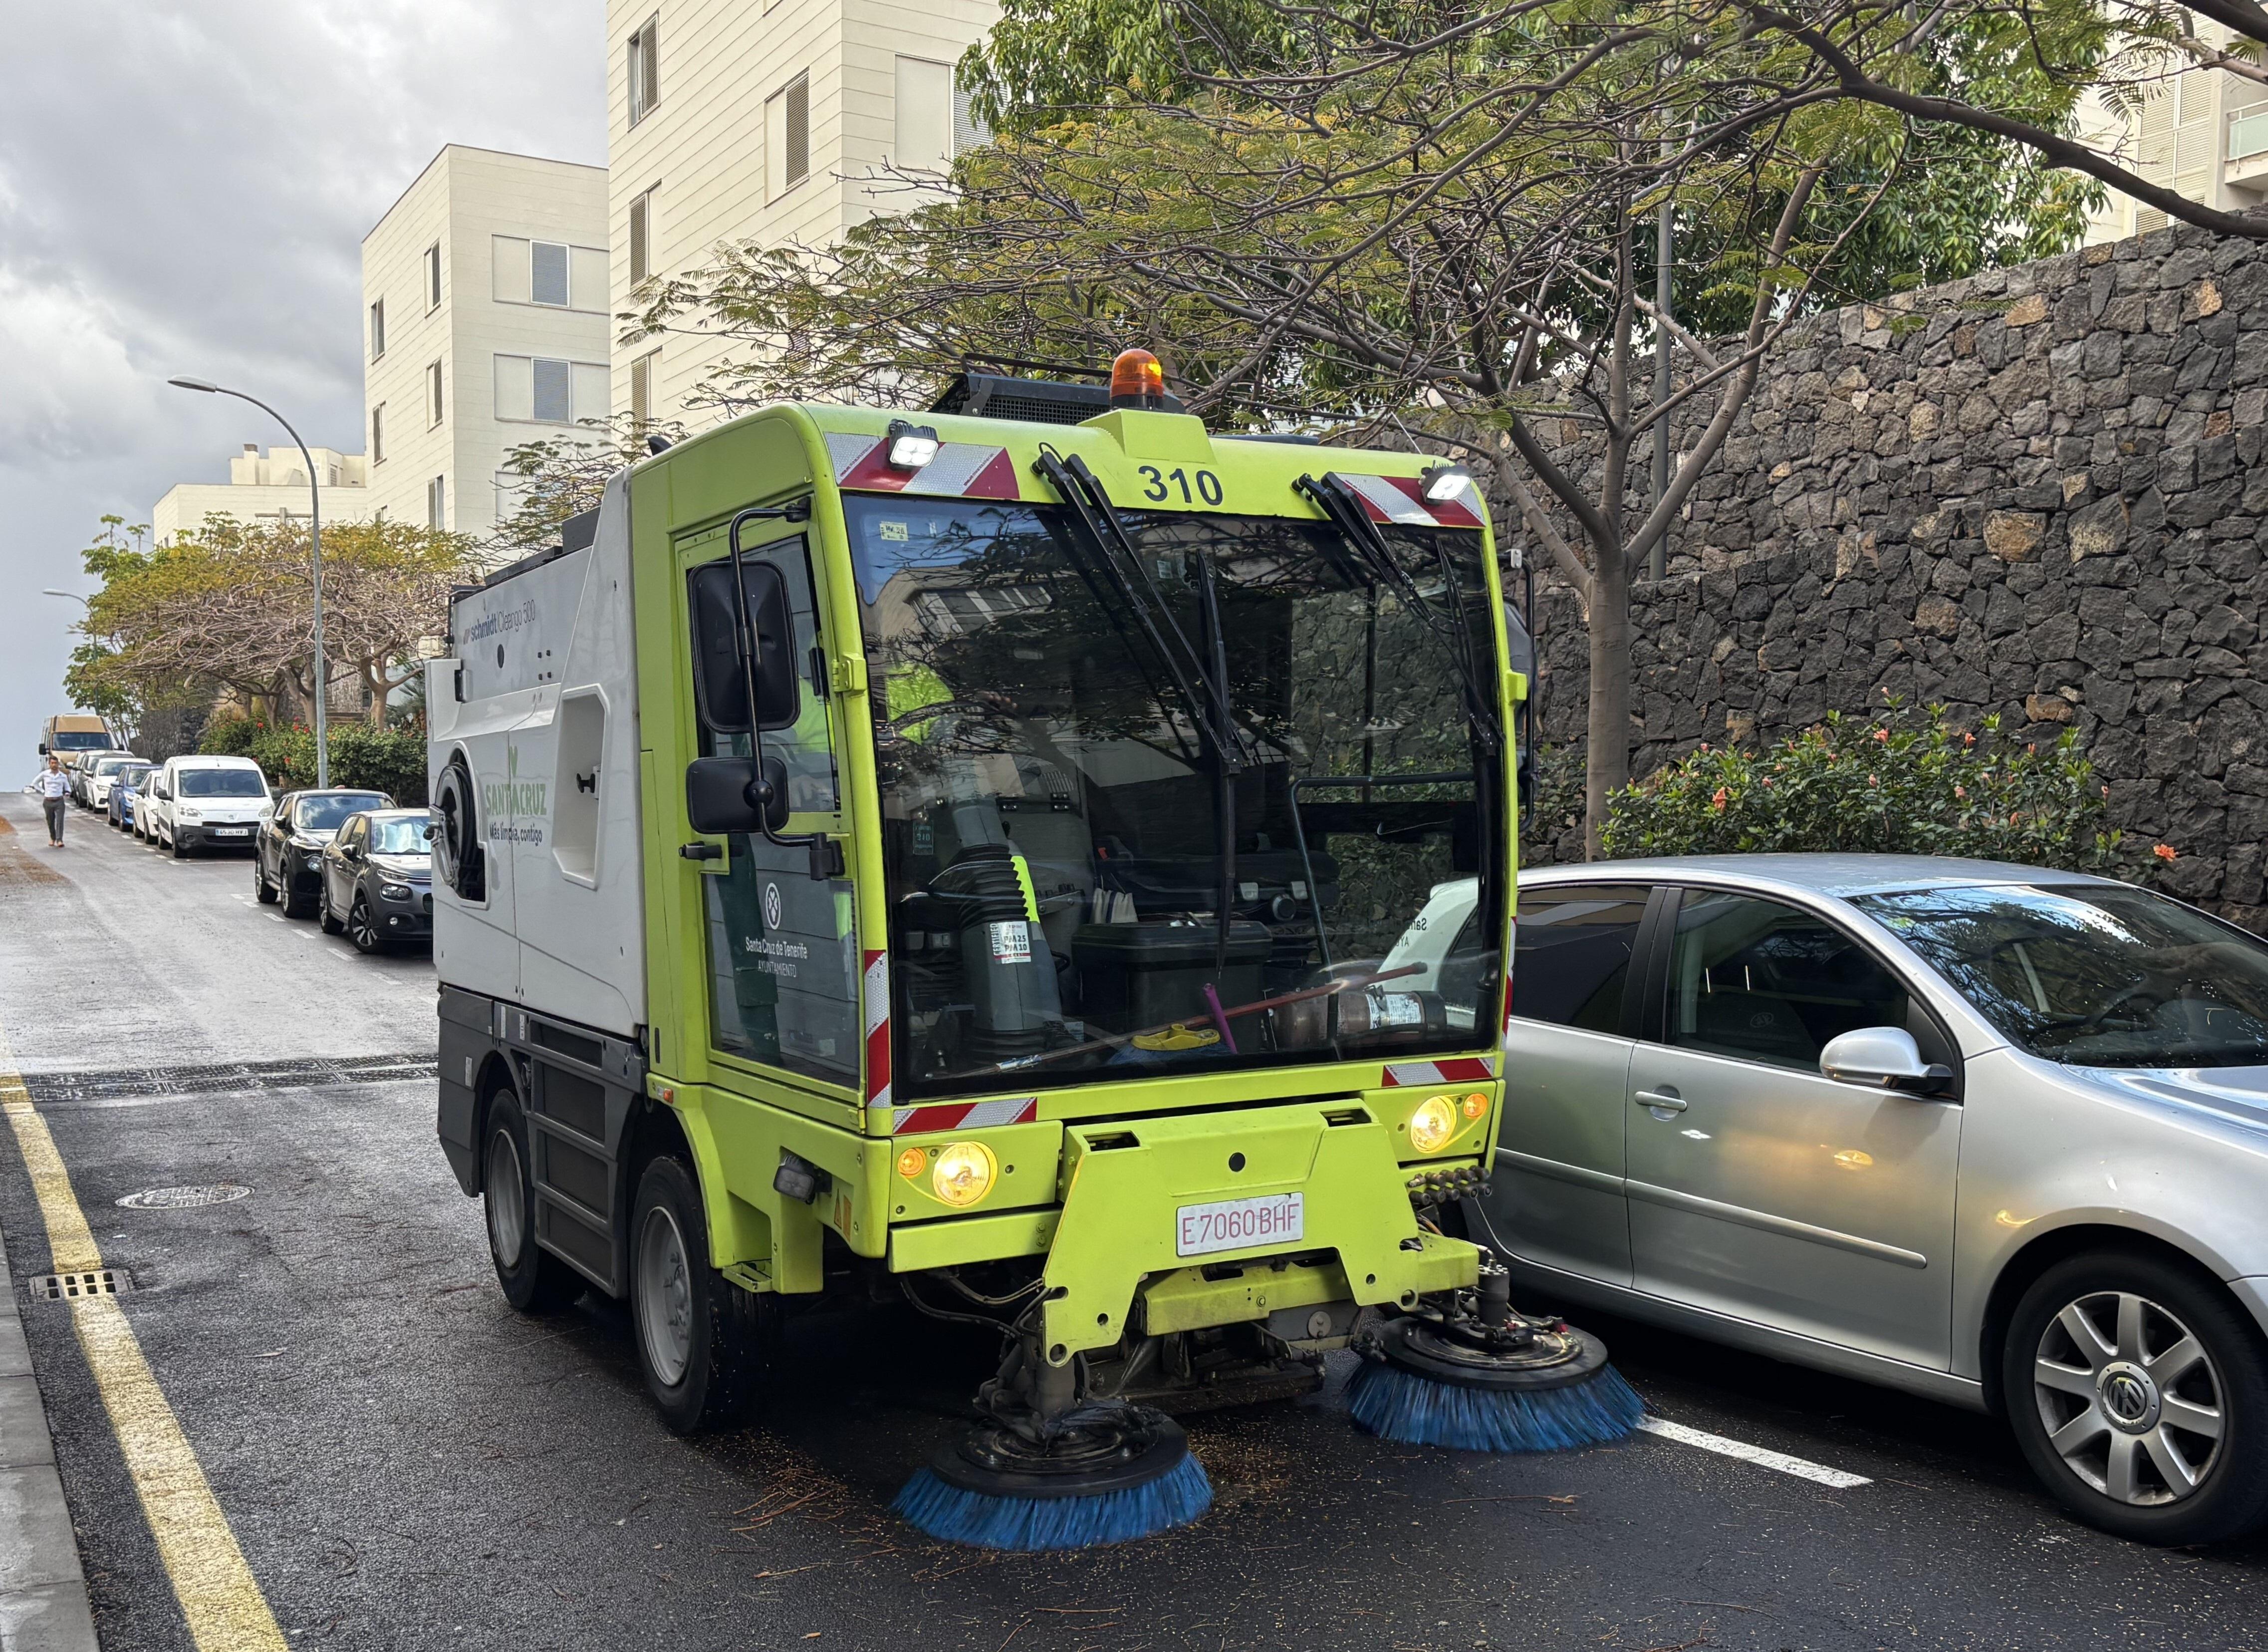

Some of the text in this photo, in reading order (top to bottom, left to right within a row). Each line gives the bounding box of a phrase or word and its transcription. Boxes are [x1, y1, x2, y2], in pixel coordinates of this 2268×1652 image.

[1138, 465, 1223, 506] 310
[471, 613, 497, 642] schmidt
[523, 599, 535, 623] 500
[520, 822, 542, 847] contigo
[746, 936, 807, 959] Santa Cruz de Tenerife
